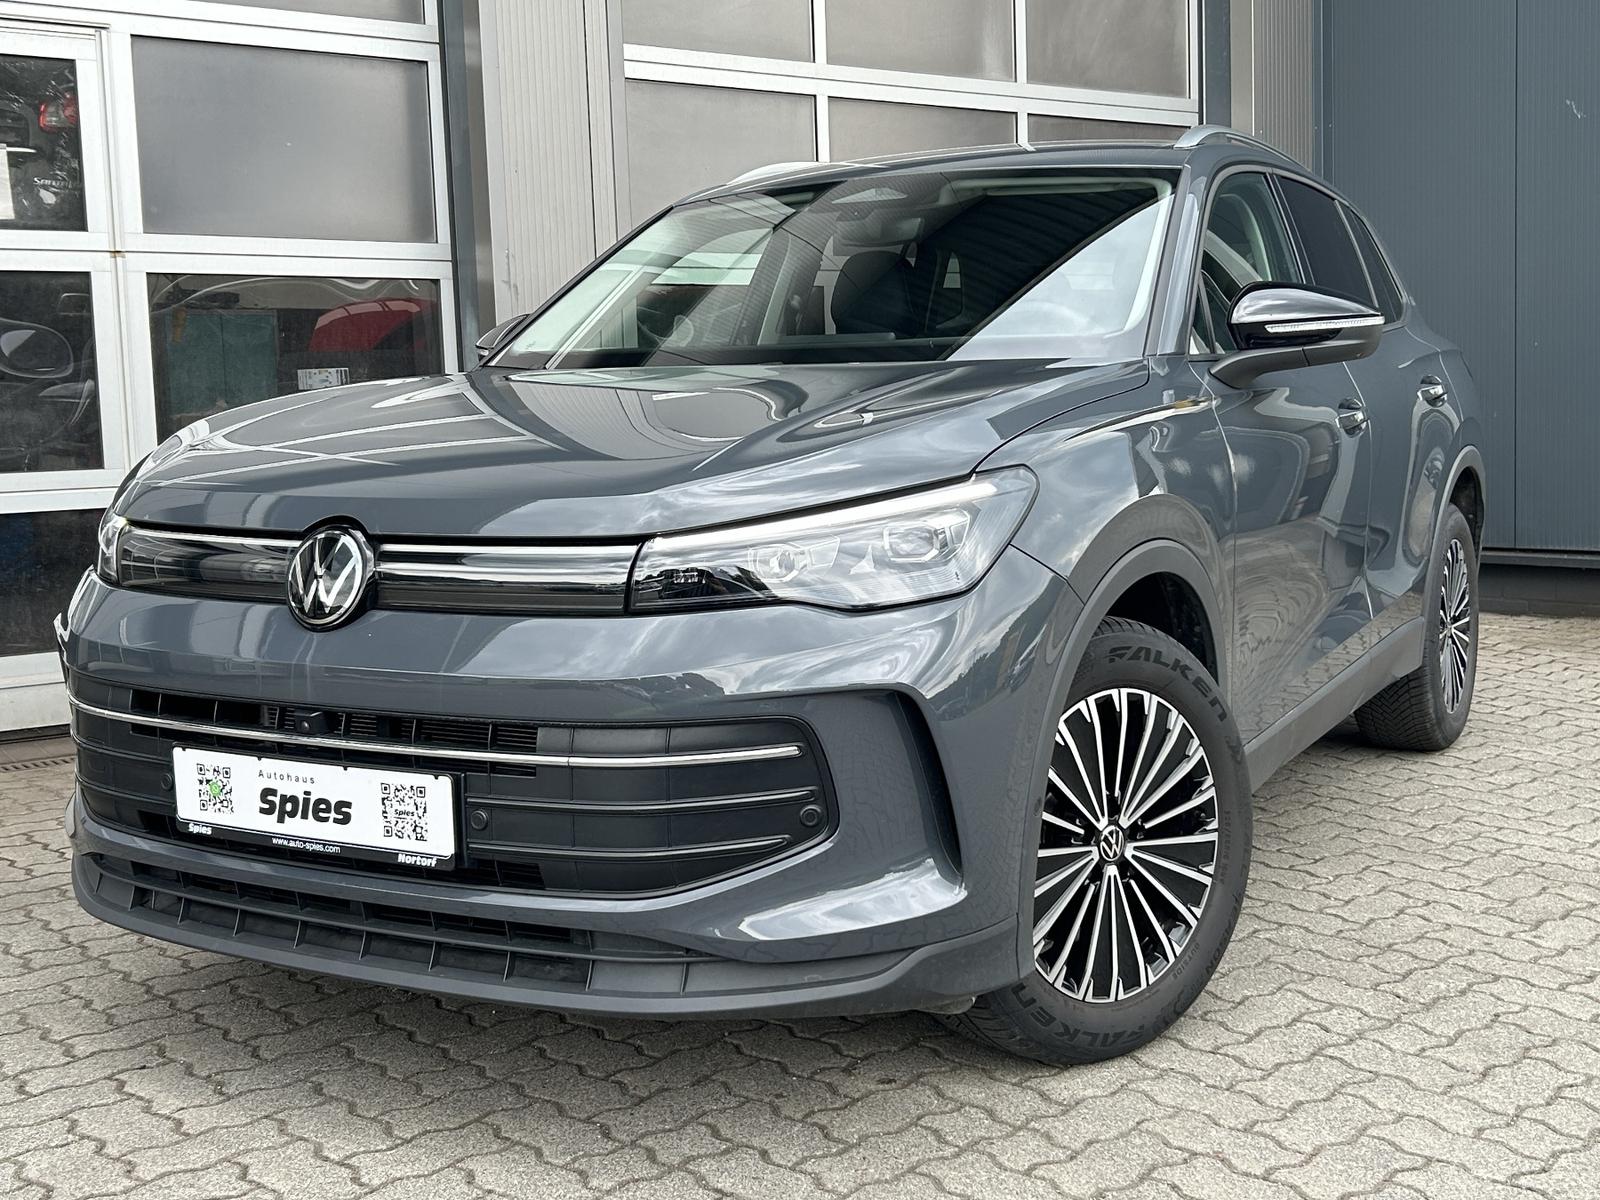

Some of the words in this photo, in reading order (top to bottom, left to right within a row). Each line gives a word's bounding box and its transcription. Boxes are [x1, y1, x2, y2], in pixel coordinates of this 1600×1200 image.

[258, 769, 315, 784] Autohaus
[259, 787, 353, 826] Spies
[394, 808, 415, 817] Spies
[188, 822, 212, 835] Spies
[272, 837, 341, 854] www.auto-spies.com
[397, 853, 437, 867] Nortorf
